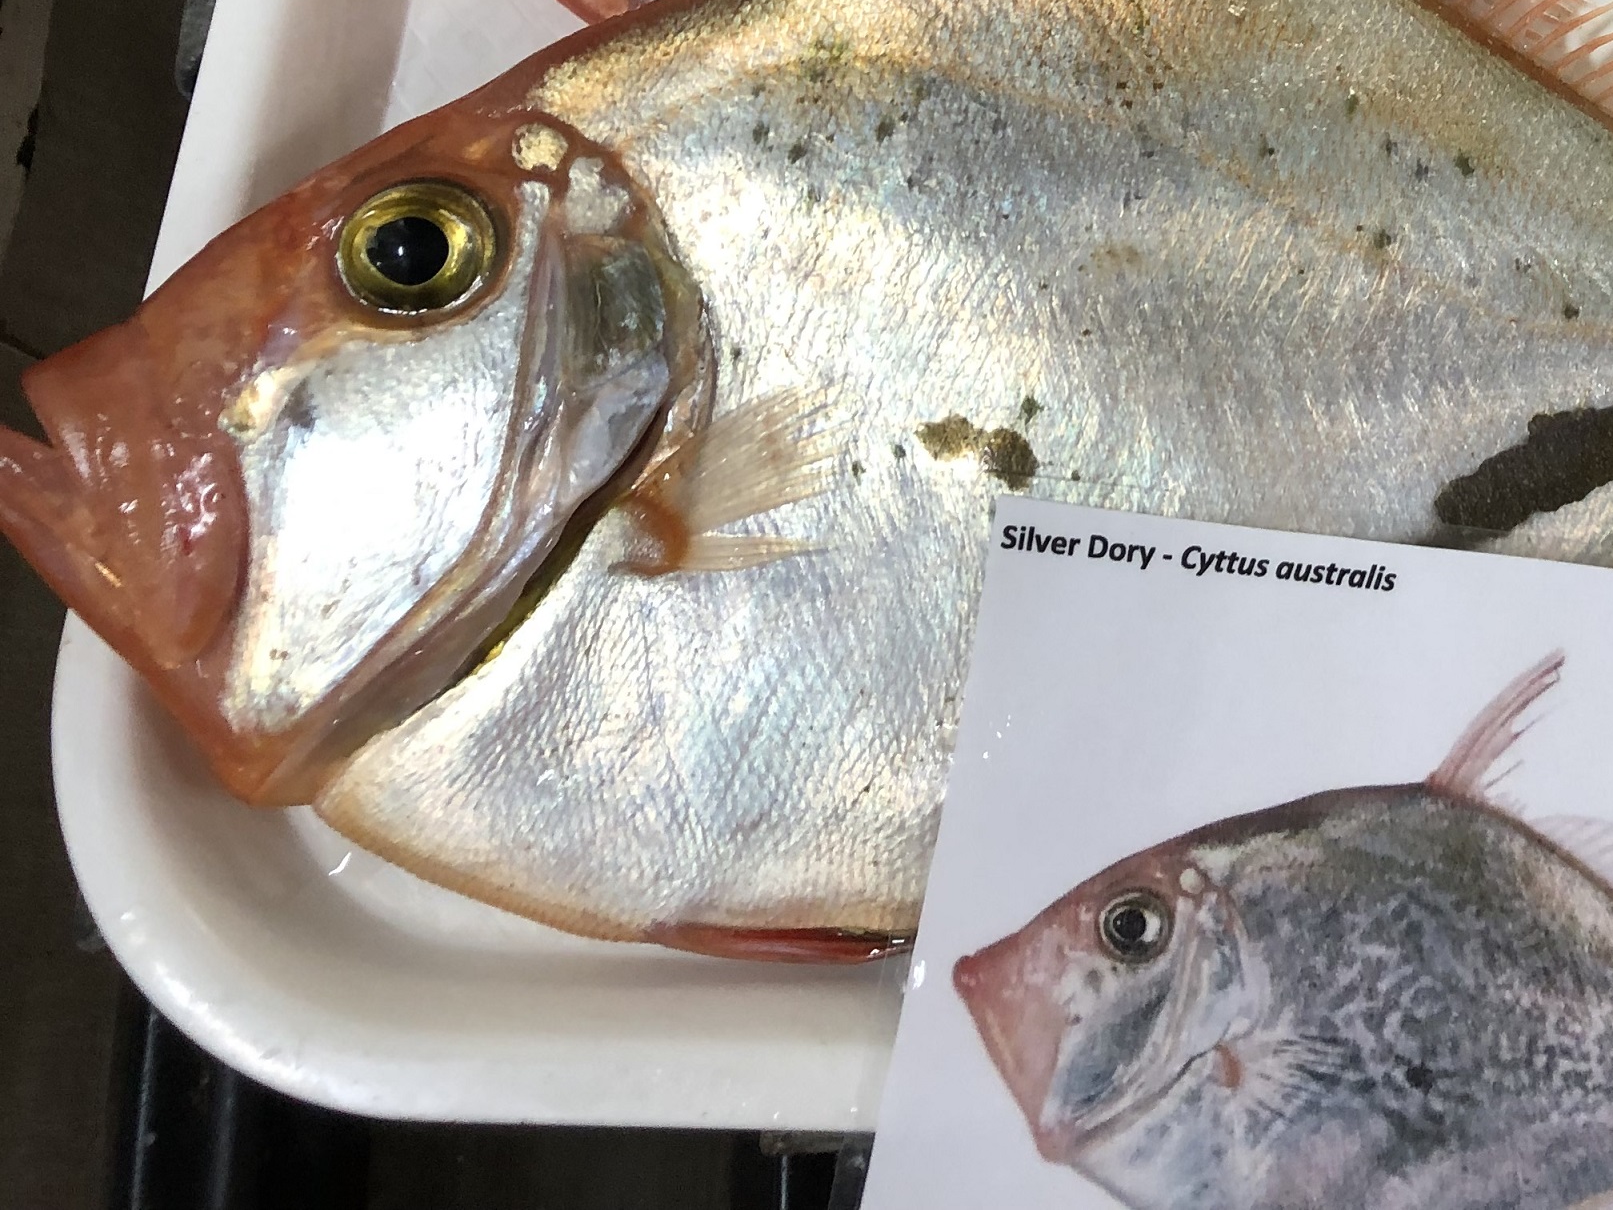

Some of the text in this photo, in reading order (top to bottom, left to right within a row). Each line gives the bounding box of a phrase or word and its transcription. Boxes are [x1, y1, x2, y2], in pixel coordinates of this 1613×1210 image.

[1000, 524, 1081, 557] Silver
[1087, 534, 1156, 570] Dory
[1180, 545, 1270, 578] Cyttus
[1275, 561, 1397, 591] australis
